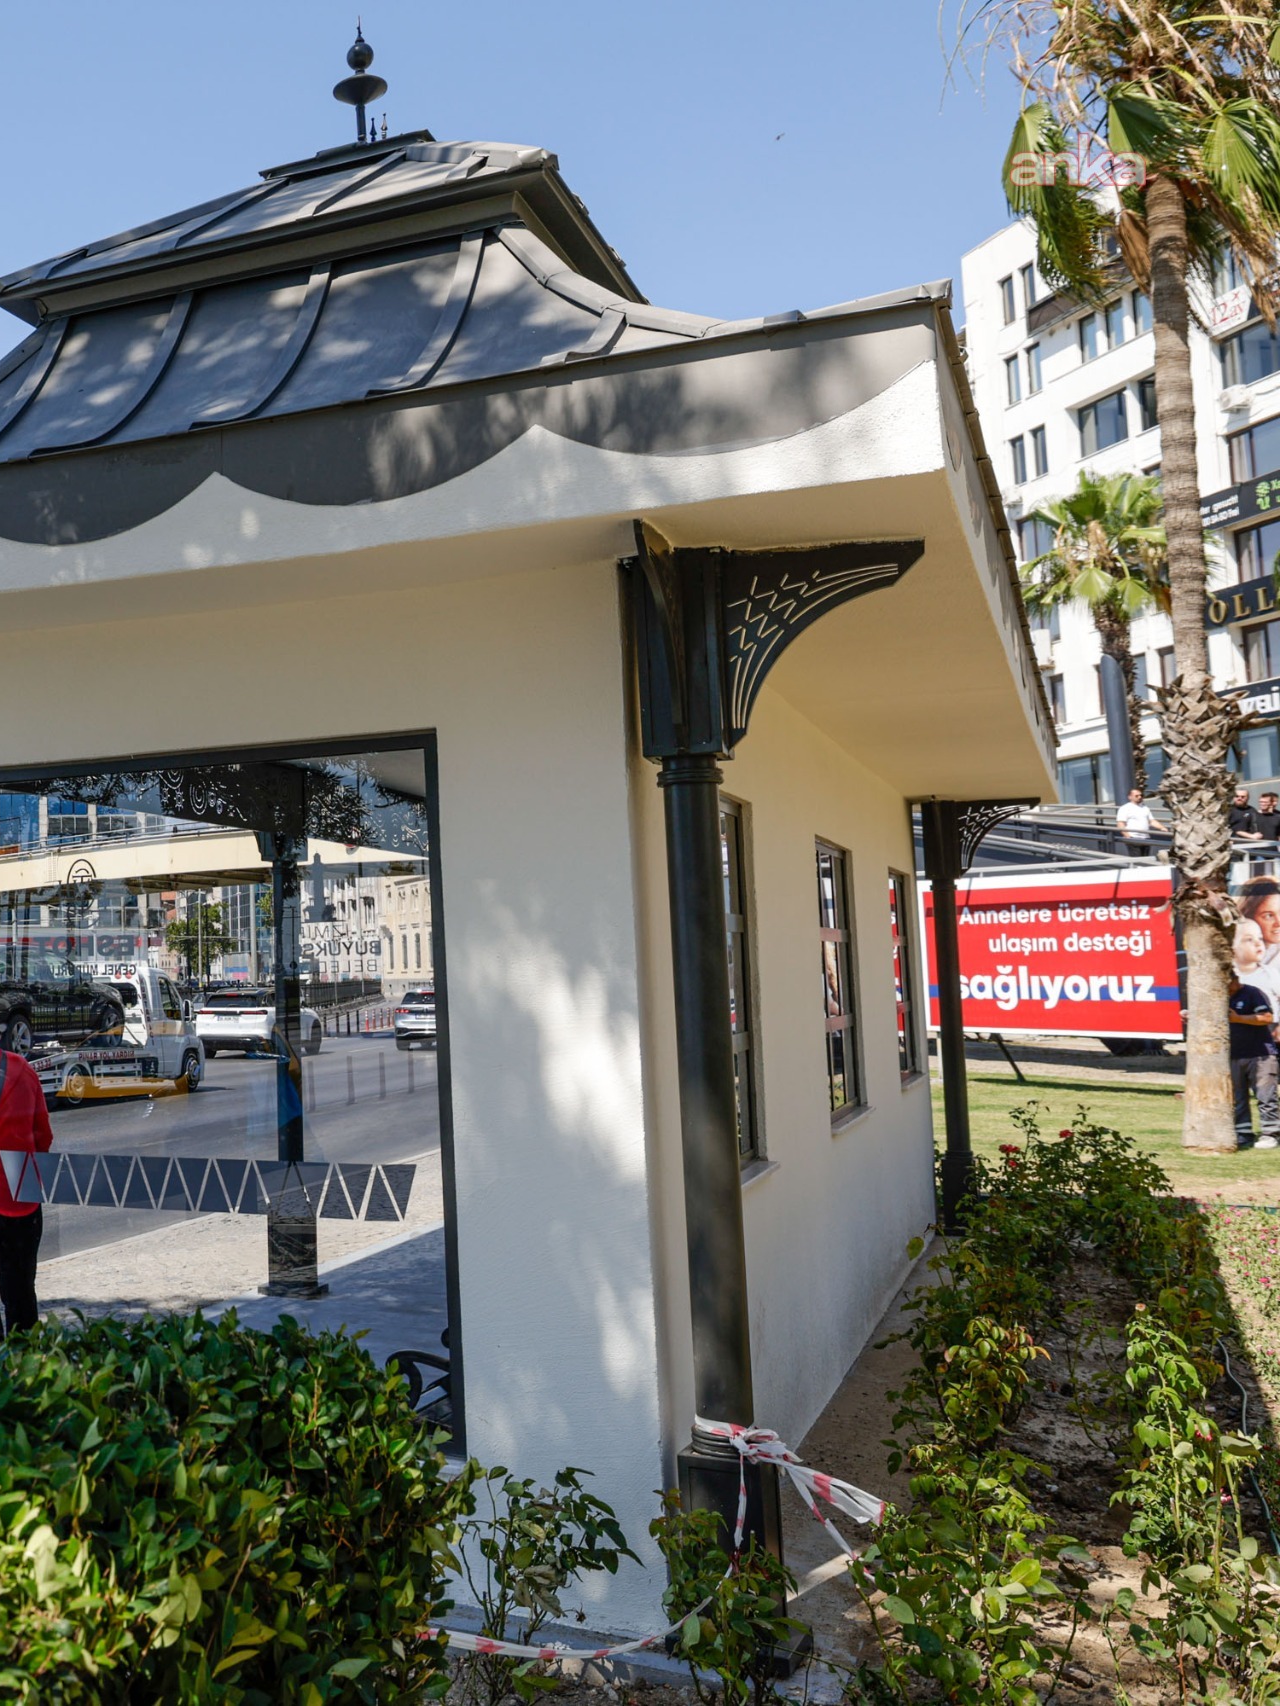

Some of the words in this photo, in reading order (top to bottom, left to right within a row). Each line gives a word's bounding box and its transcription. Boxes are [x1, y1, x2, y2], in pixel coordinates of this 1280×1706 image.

[959, 905, 1052, 925] Annelere
[1058, 900, 1151, 922] ücretsiz
[989, 933, 1058, 956] ulaşım
[1063, 930, 1152, 957] desteği
